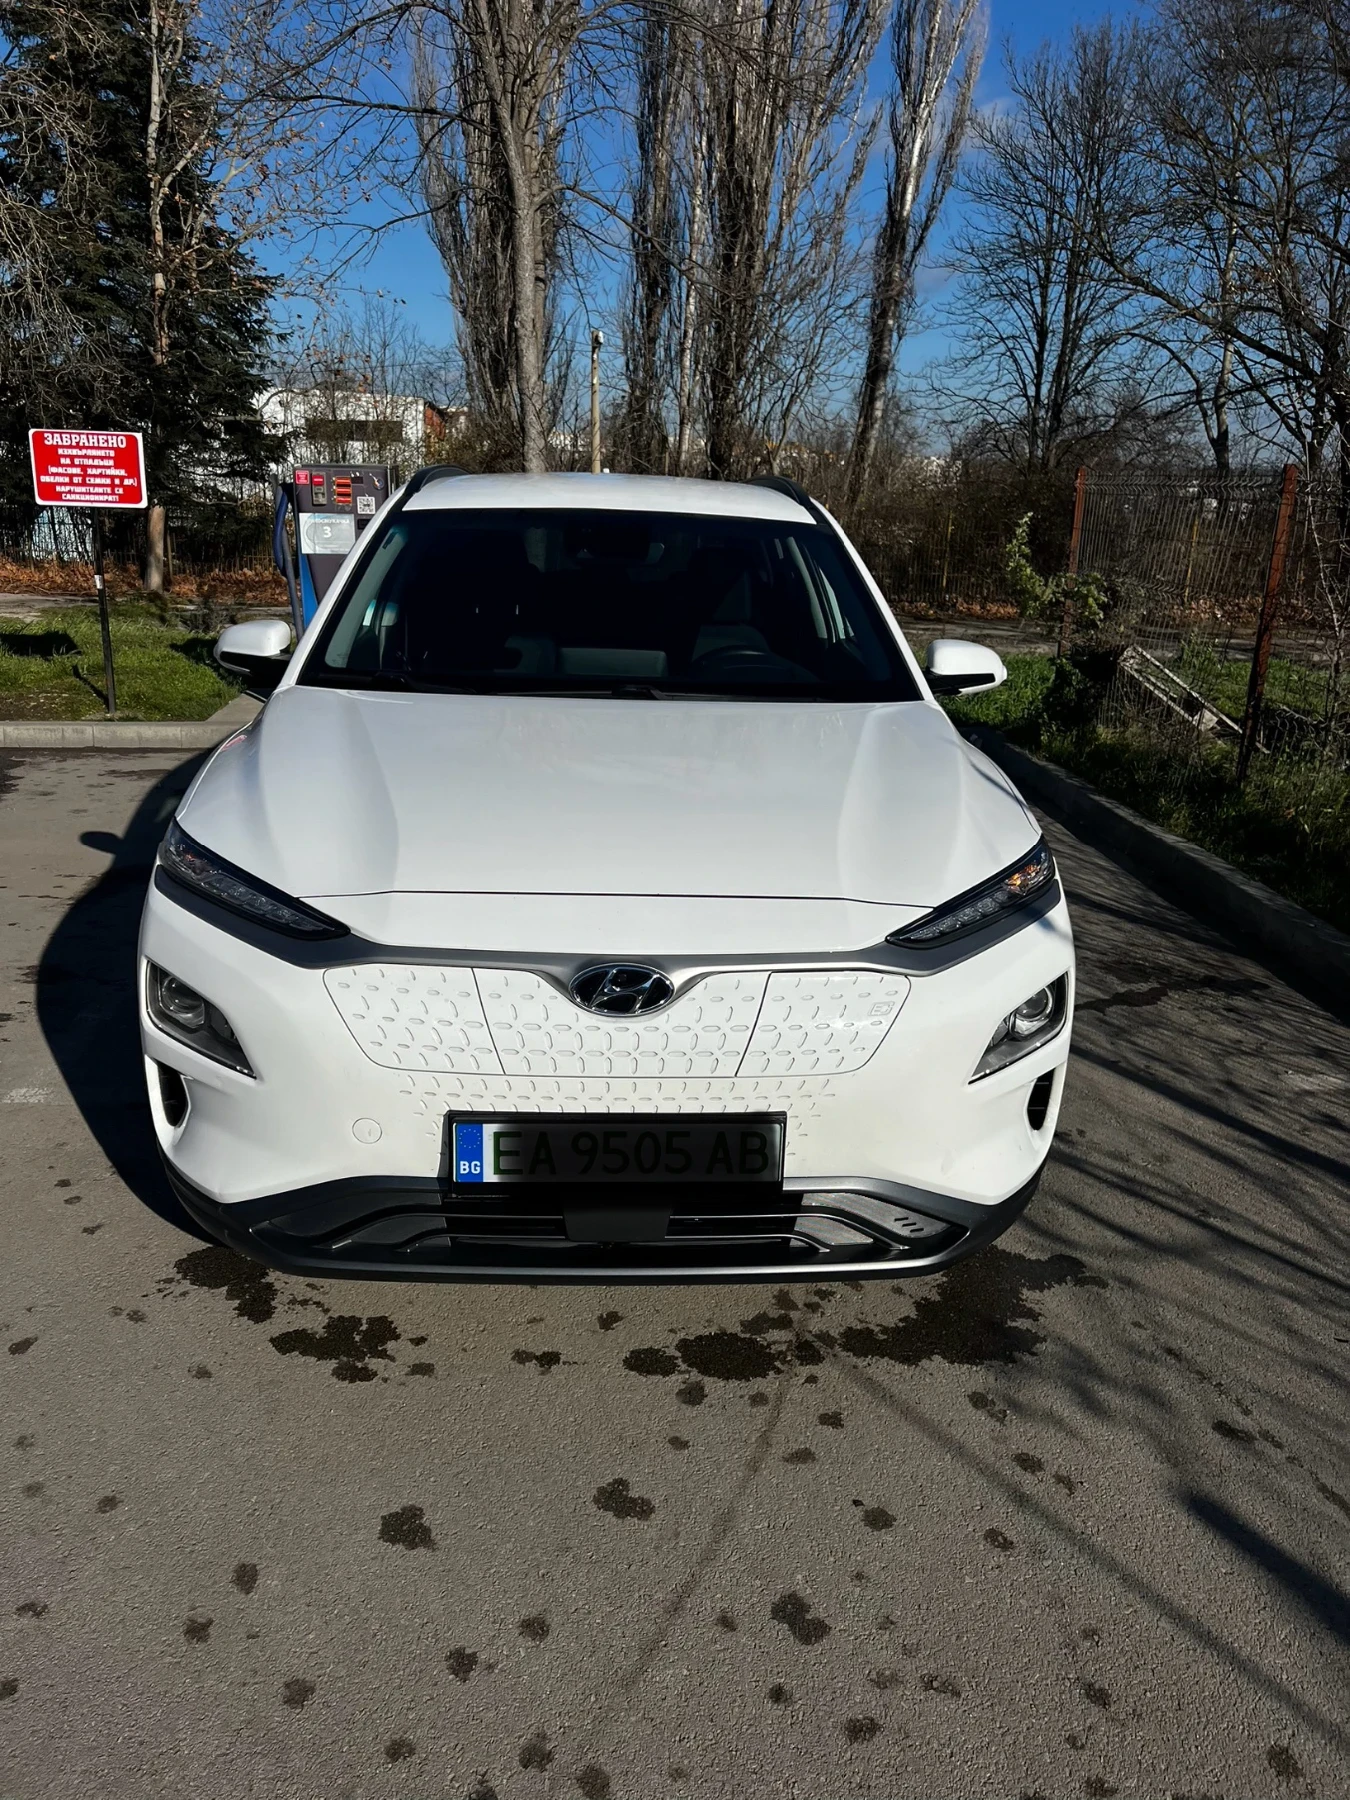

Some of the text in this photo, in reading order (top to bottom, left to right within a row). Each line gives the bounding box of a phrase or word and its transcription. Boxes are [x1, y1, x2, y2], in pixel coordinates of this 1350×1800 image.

[44, 433, 127, 448] ЗАБРАНЕНО
[57, 448, 115, 457] ИЗХВЪРЛЯНЕТО
[60, 457, 114, 466] НА ОТПАДЪЦИ
[40, 475, 69, 483] ОБЕЛКИ
[73, 476, 82, 484] ОТ
[86, 477, 111, 485] СЕМКИ
[56, 485, 124, 494] НАРУШИТЕЛИТЕ СЕ
[323, 525, 332, 538] 3
[492, 1130, 770, 1176] EA 9505 AB
[459, 1160, 481, 1175] BG
